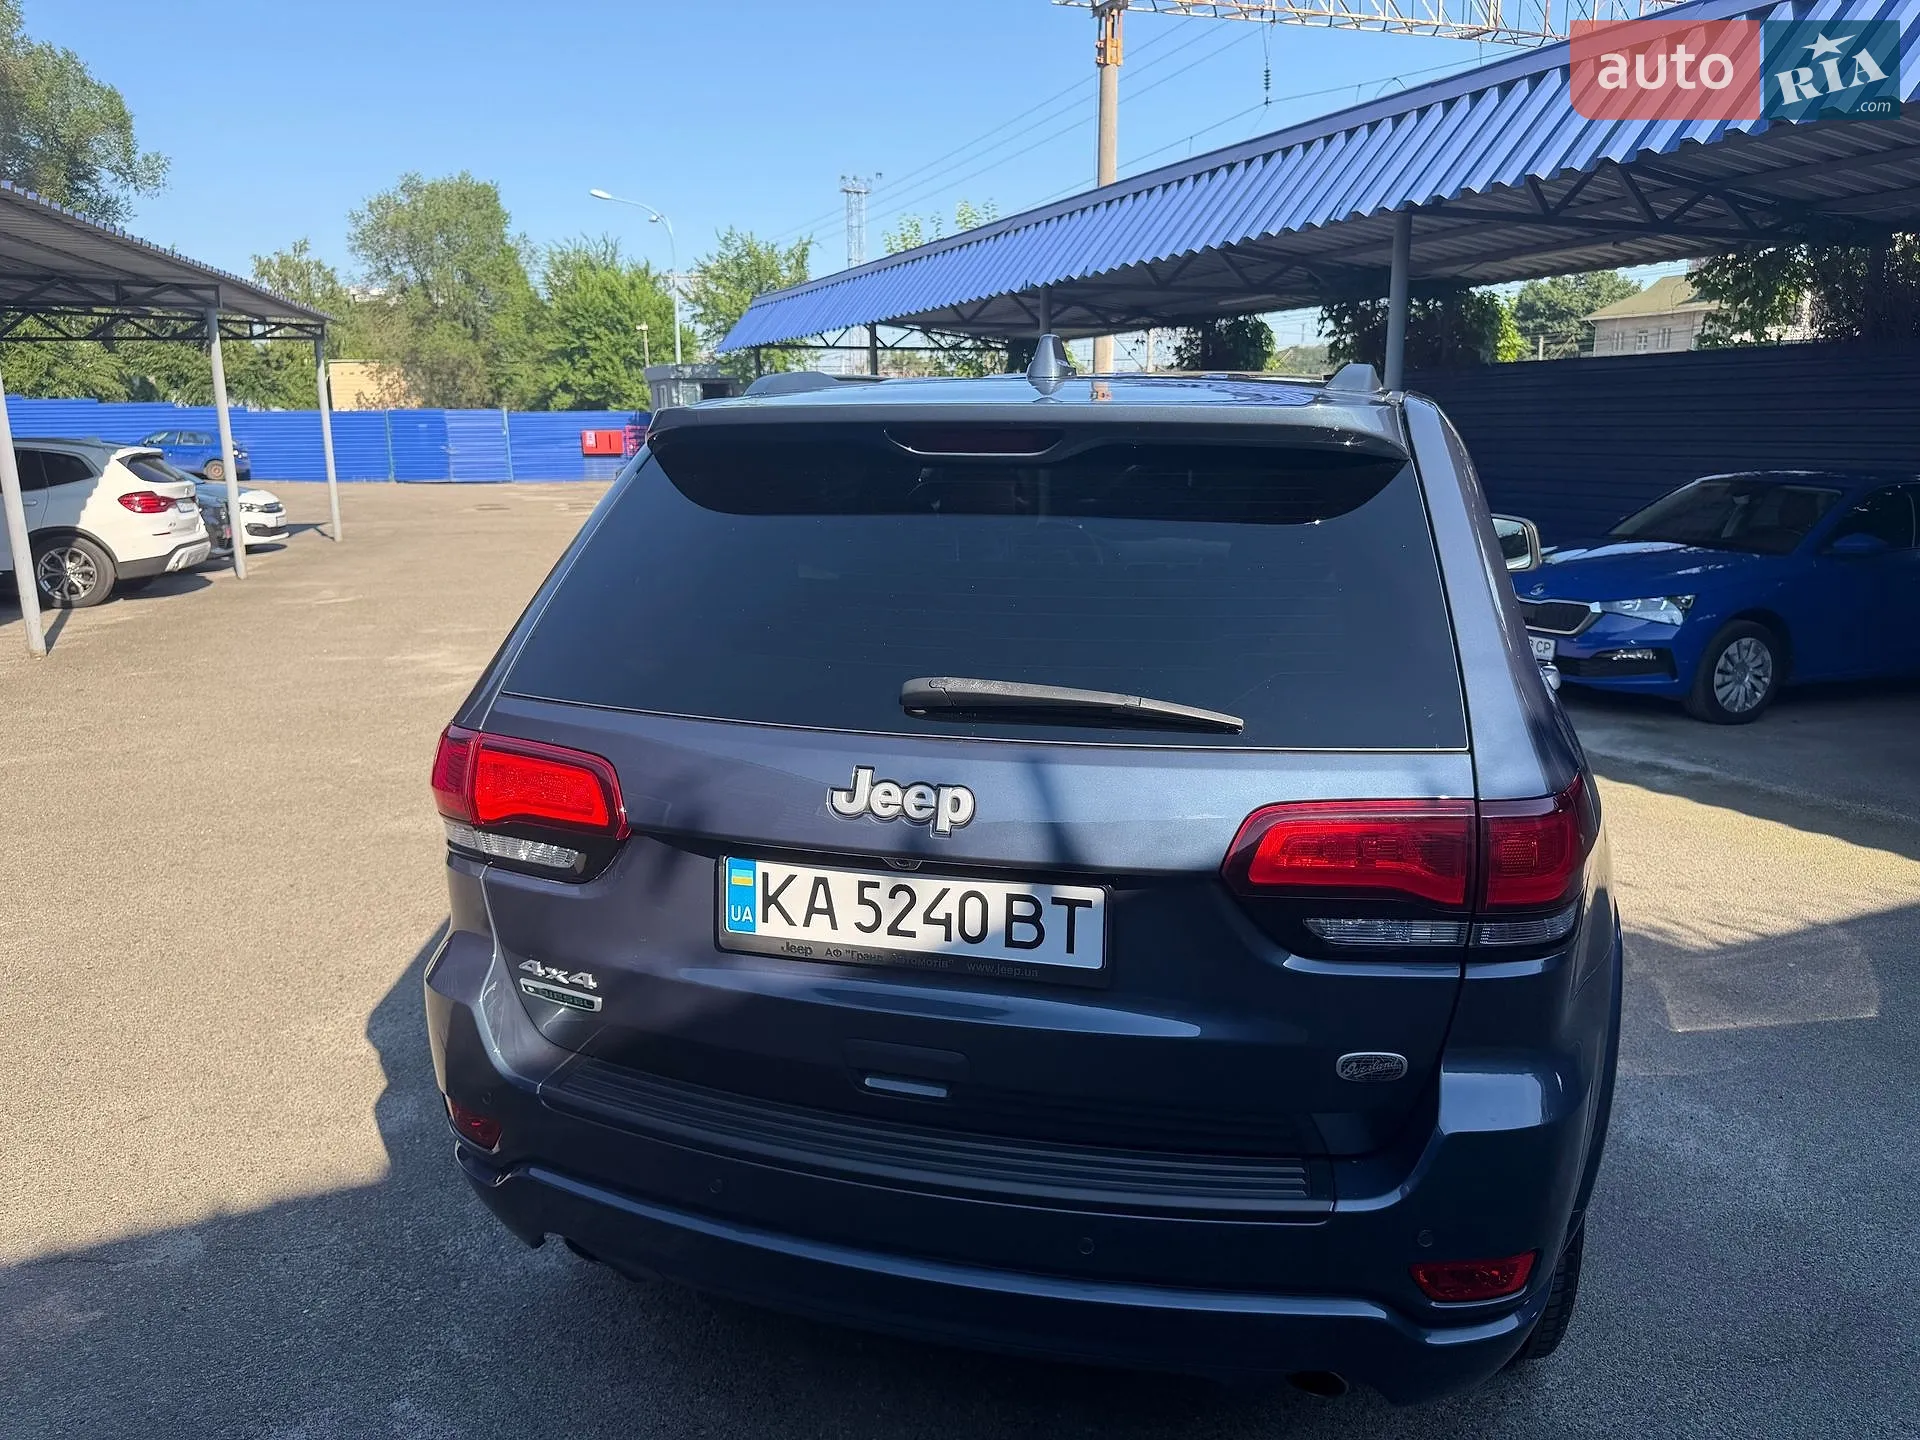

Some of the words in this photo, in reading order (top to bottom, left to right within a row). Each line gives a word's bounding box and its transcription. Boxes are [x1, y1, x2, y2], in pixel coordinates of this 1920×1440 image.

[831, 768, 975, 833] Jeep
[731, 904, 753, 923] UA
[761, 871, 839, 931] KA
[854, 880, 989, 944] 5240
[1004, 893, 1093, 954] BT
[780, 941, 813, 957] Jeep
